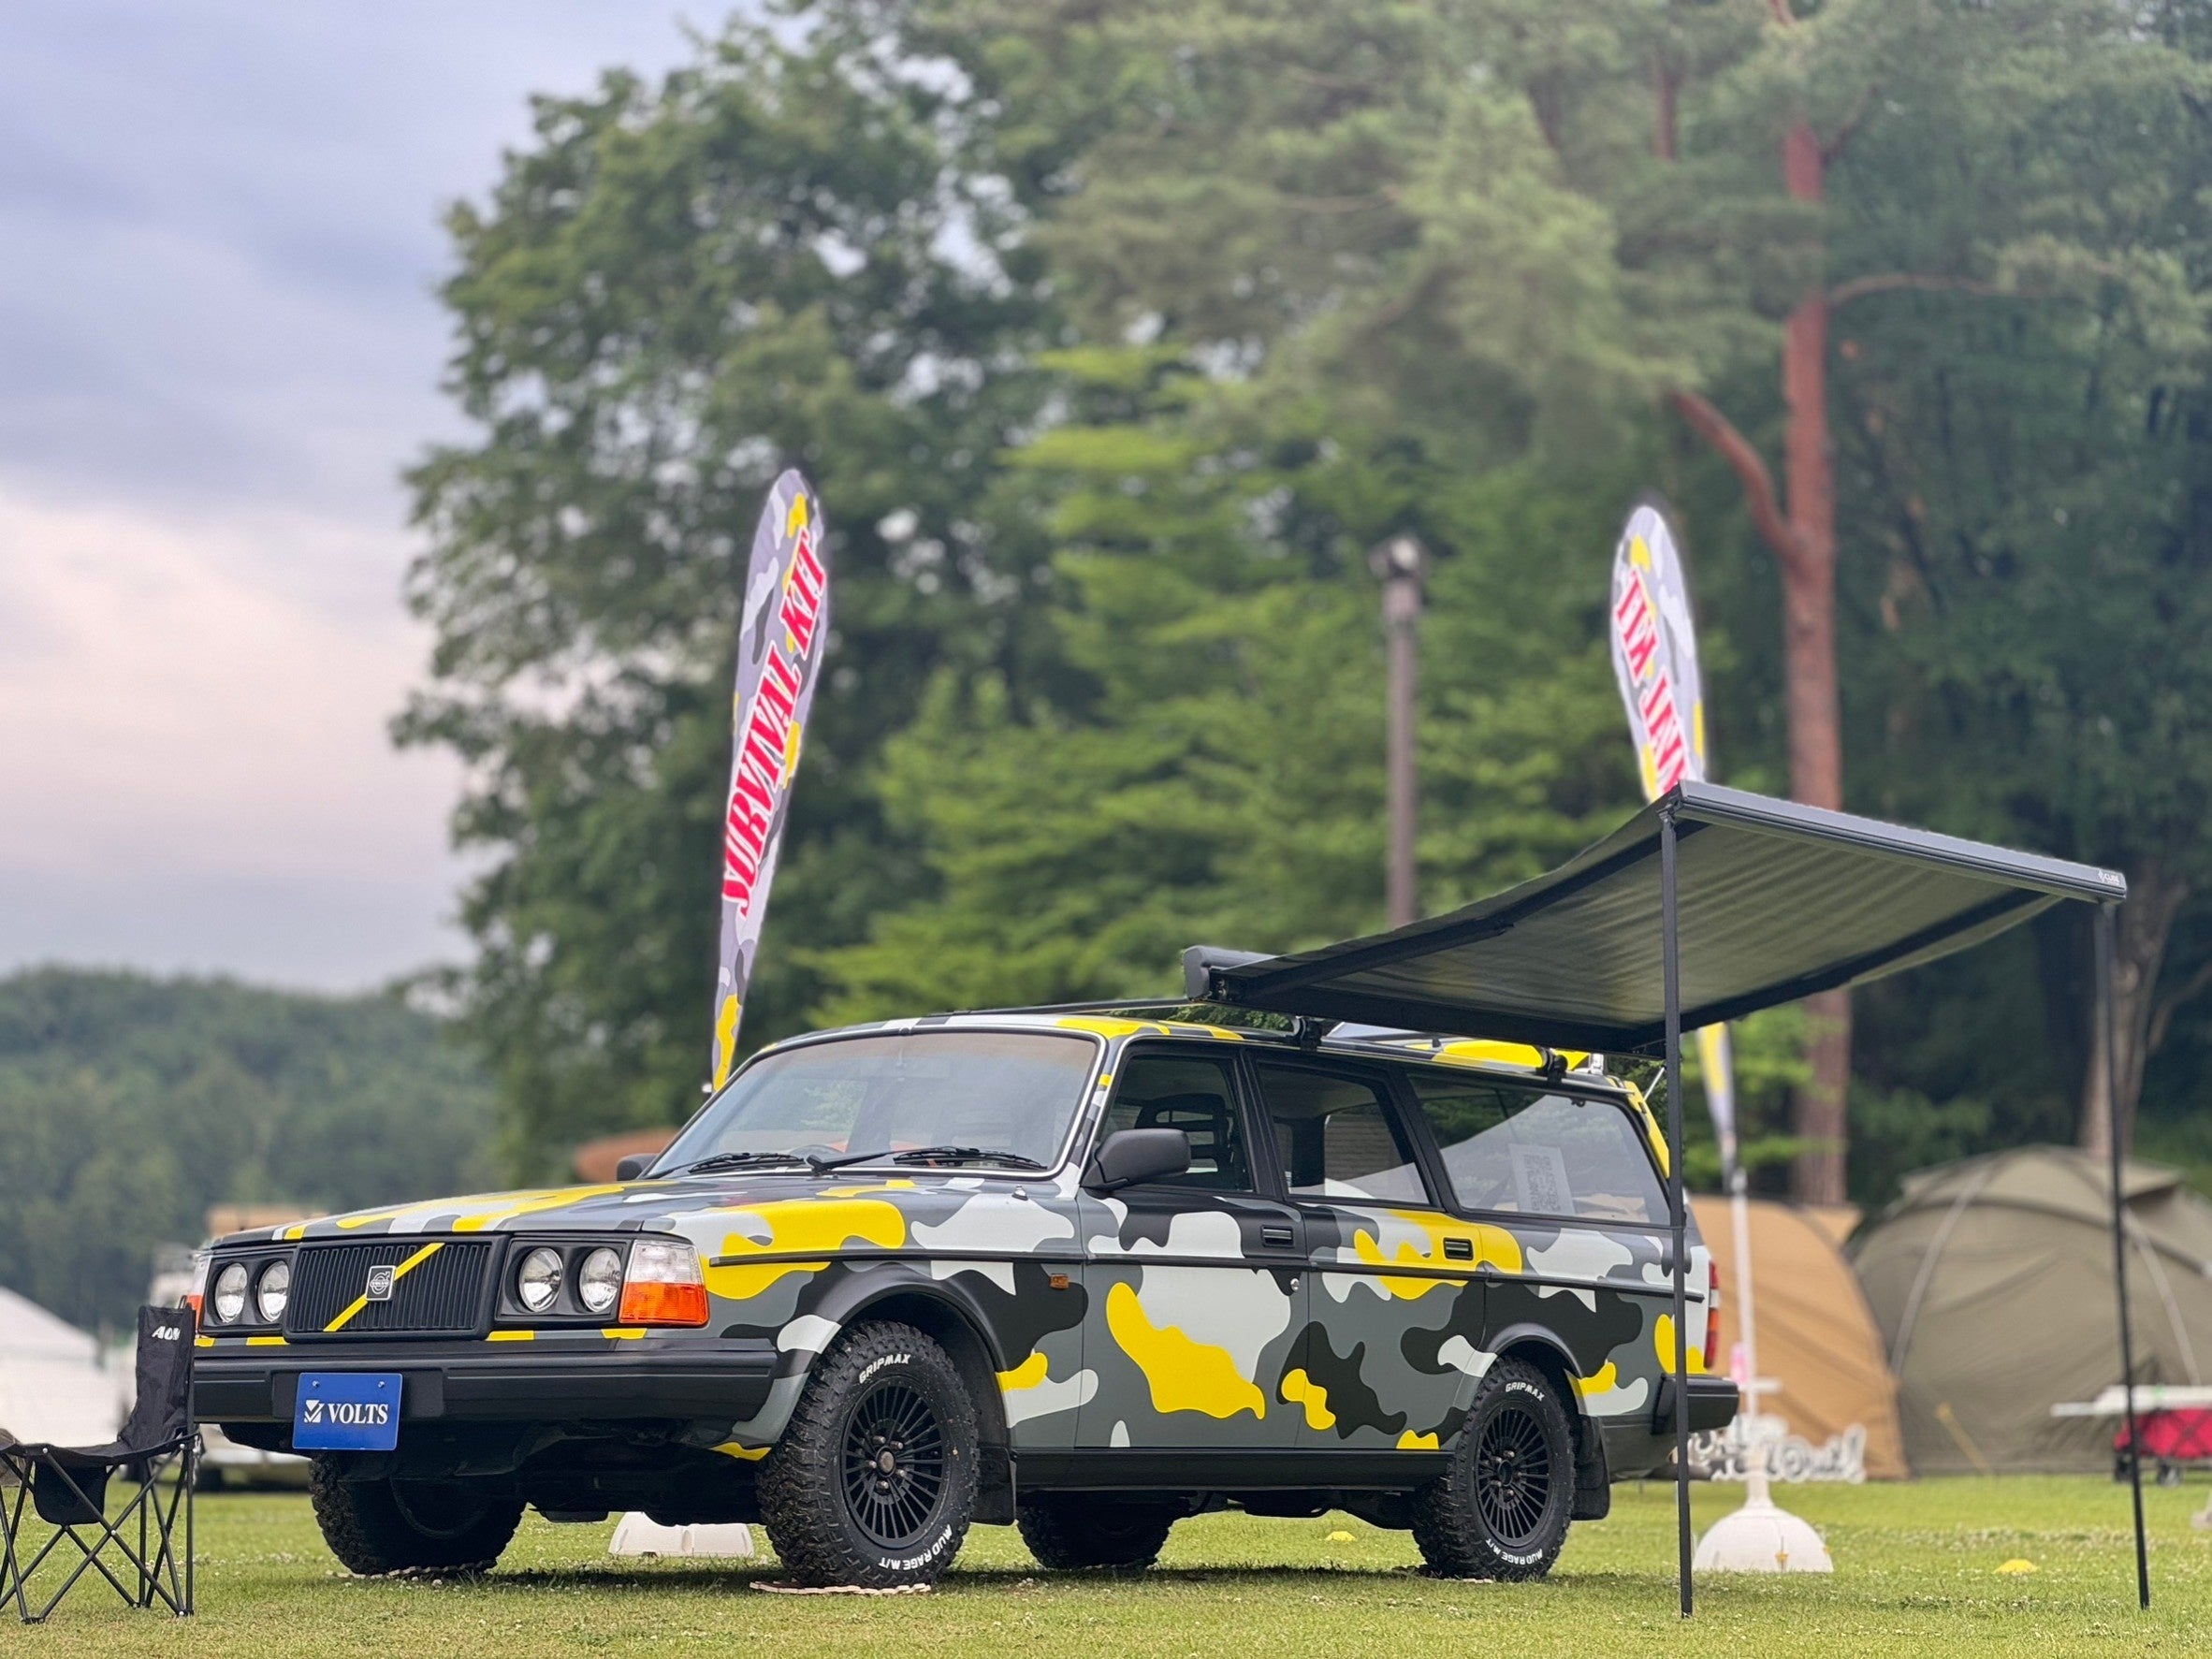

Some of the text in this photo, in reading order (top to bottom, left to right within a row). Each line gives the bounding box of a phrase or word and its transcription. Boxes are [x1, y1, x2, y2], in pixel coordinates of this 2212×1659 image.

[722, 527, 825, 918] SURVIVAL KIT
[859, 1353, 911, 1384] GRIPMAX
[1505, 1381, 1545, 1402] GRIPMAX
[327, 1403, 389, 1424] VOLTS
[878, 1523, 953, 1571] MUD RAGE M/T
[1501, 1550, 1526, 1565] RAGE
[1526, 1548, 1543, 1564] MUD
